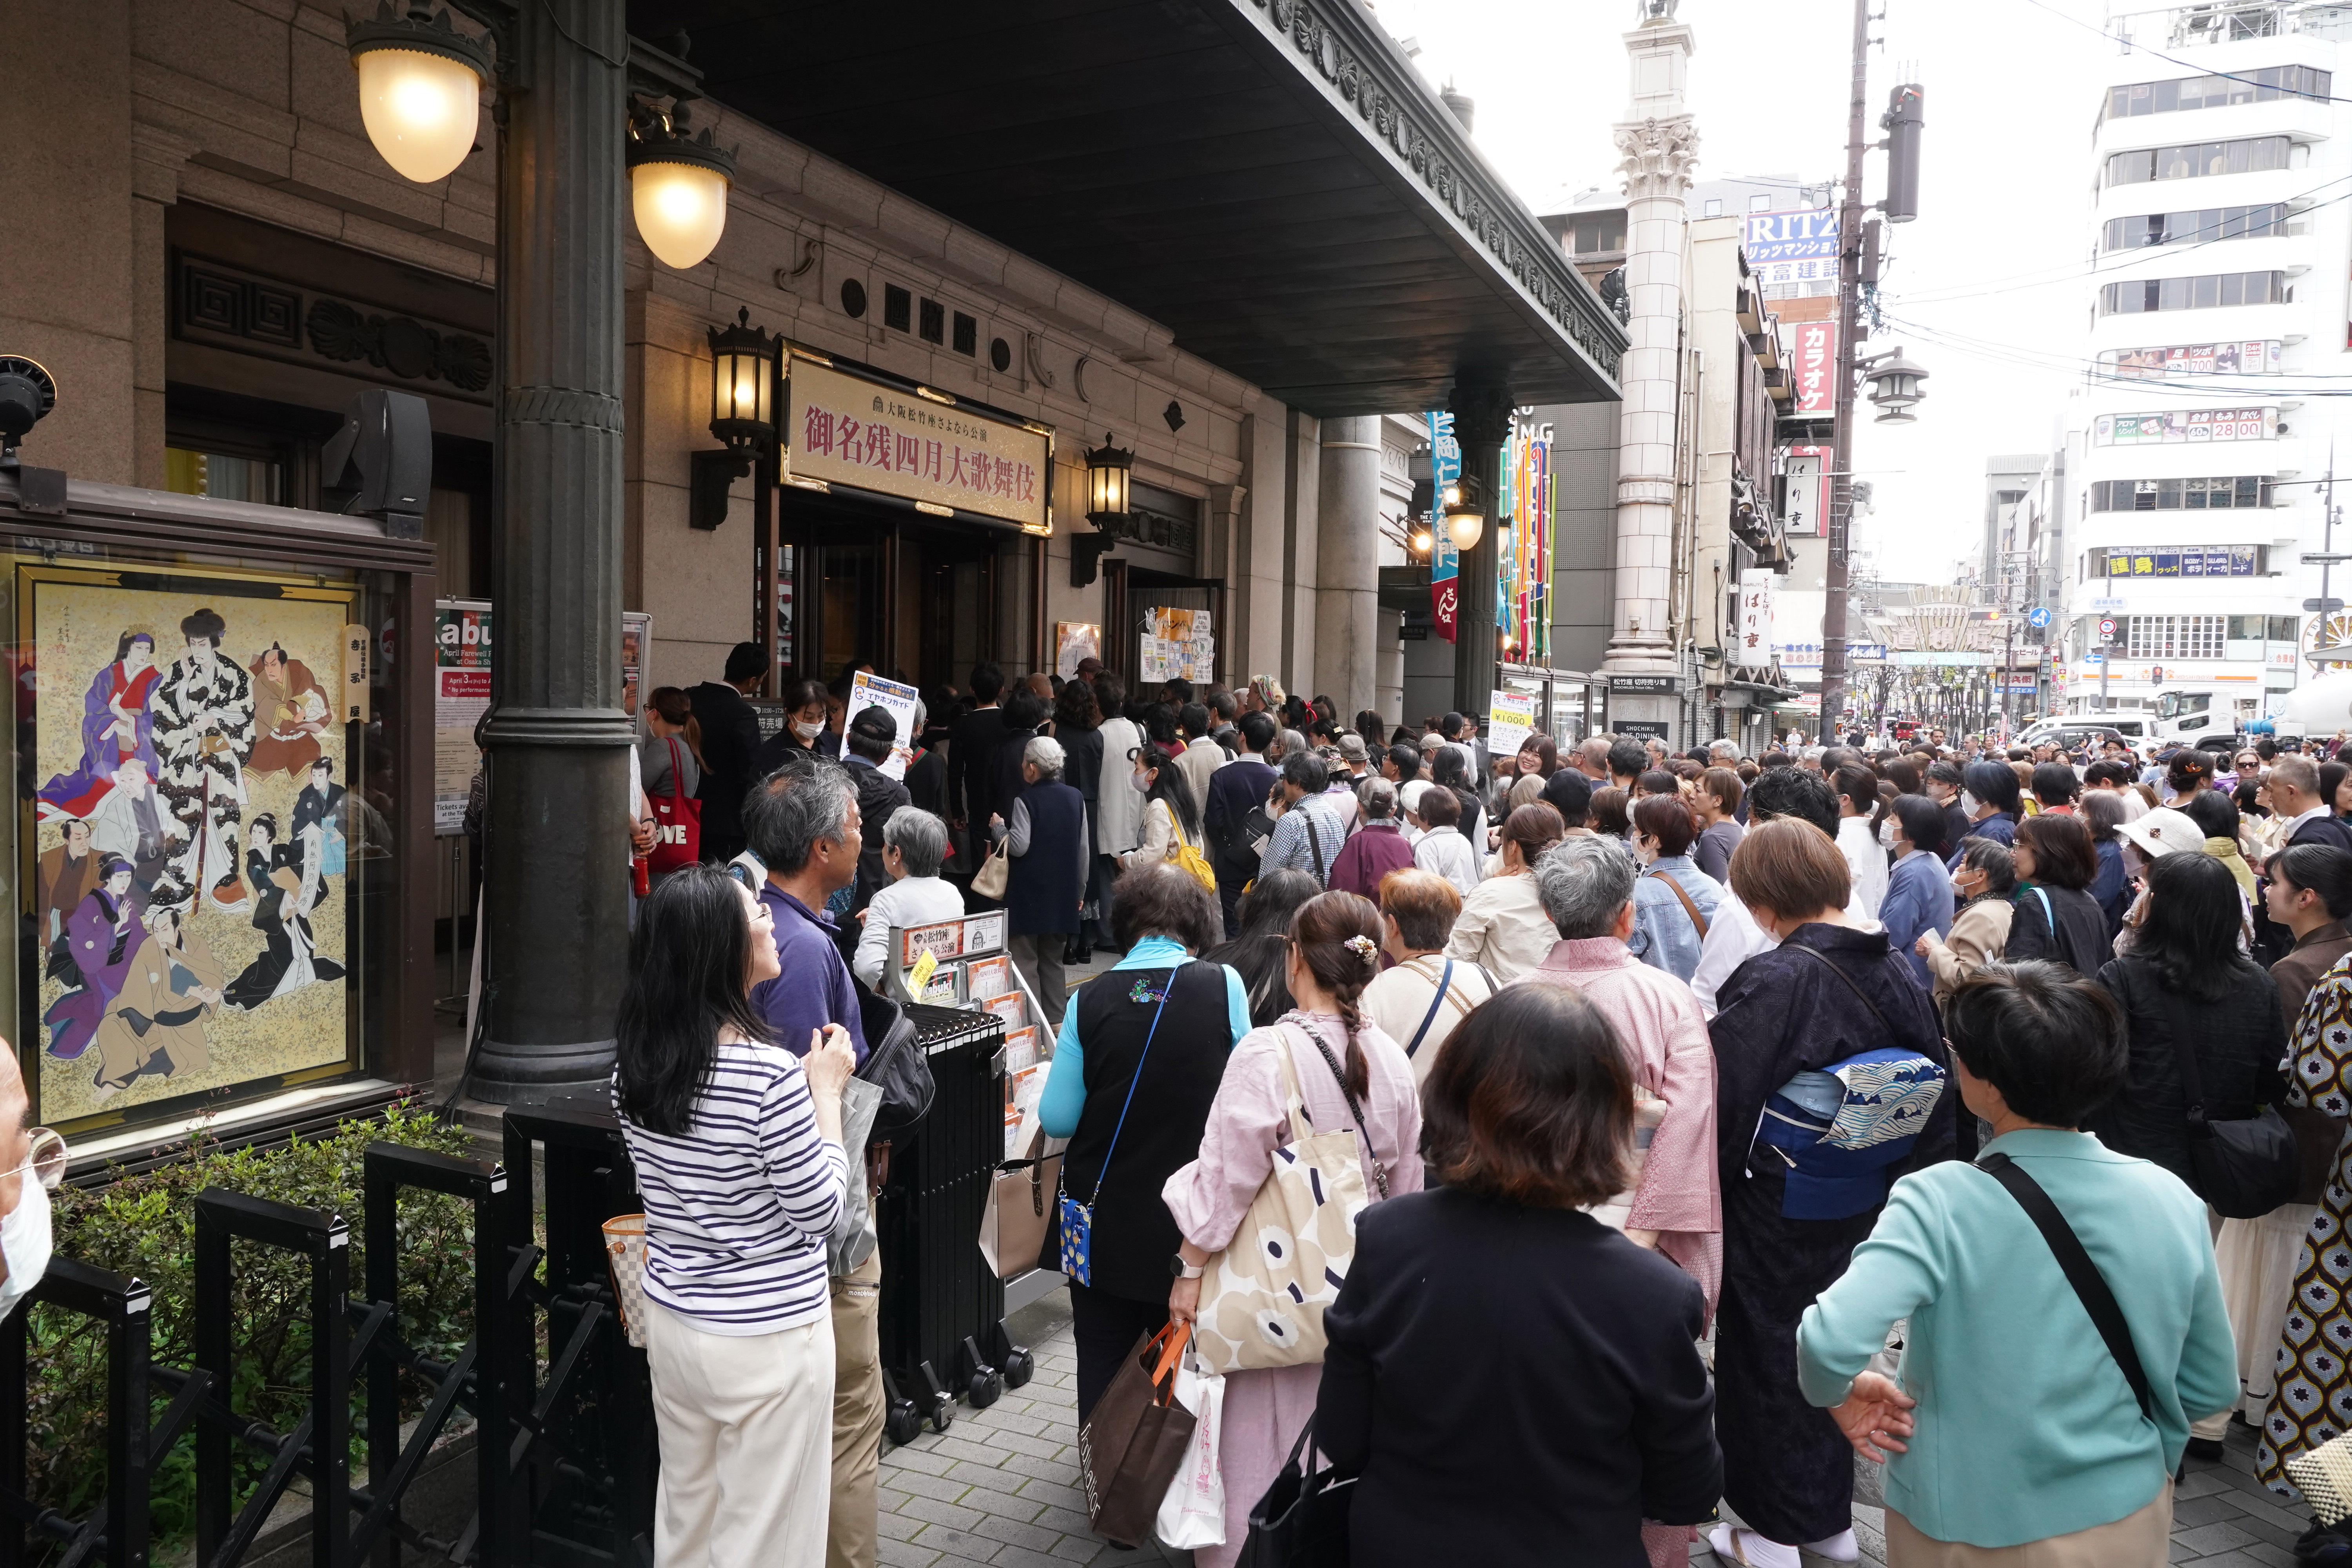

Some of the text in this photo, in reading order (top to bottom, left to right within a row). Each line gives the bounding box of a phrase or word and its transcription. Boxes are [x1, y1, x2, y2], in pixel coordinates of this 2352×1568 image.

[1749, 209, 1840, 243] RITZ
[1804, 327, 1825, 409] カラオケ
[887, 401, 987, 442] 大阪松竹座さよなら公演
[804, 405, 1035, 504] 御名残四月大歌舞伎
[1788, 465, 1804, 526] はり重
[1743, 593, 1759, 648] はり重
[1847, 645, 1882, 658] Asahi
[2276, 654, 2294, 663] 吉野家
[2141, 670, 2174, 679] 吉家
[868, 693, 909, 709] イヤホンガイド
[1503, 698, 1532, 706] イヤホンガイド
[1493, 726, 1528, 736] イヤホンガイド
[928, 929, 949, 944] 松竹座
[911, 942, 955, 959] さよら公演
[914, 965, 924, 979] Miss
[919, 965, 932, 984] Kabuki
